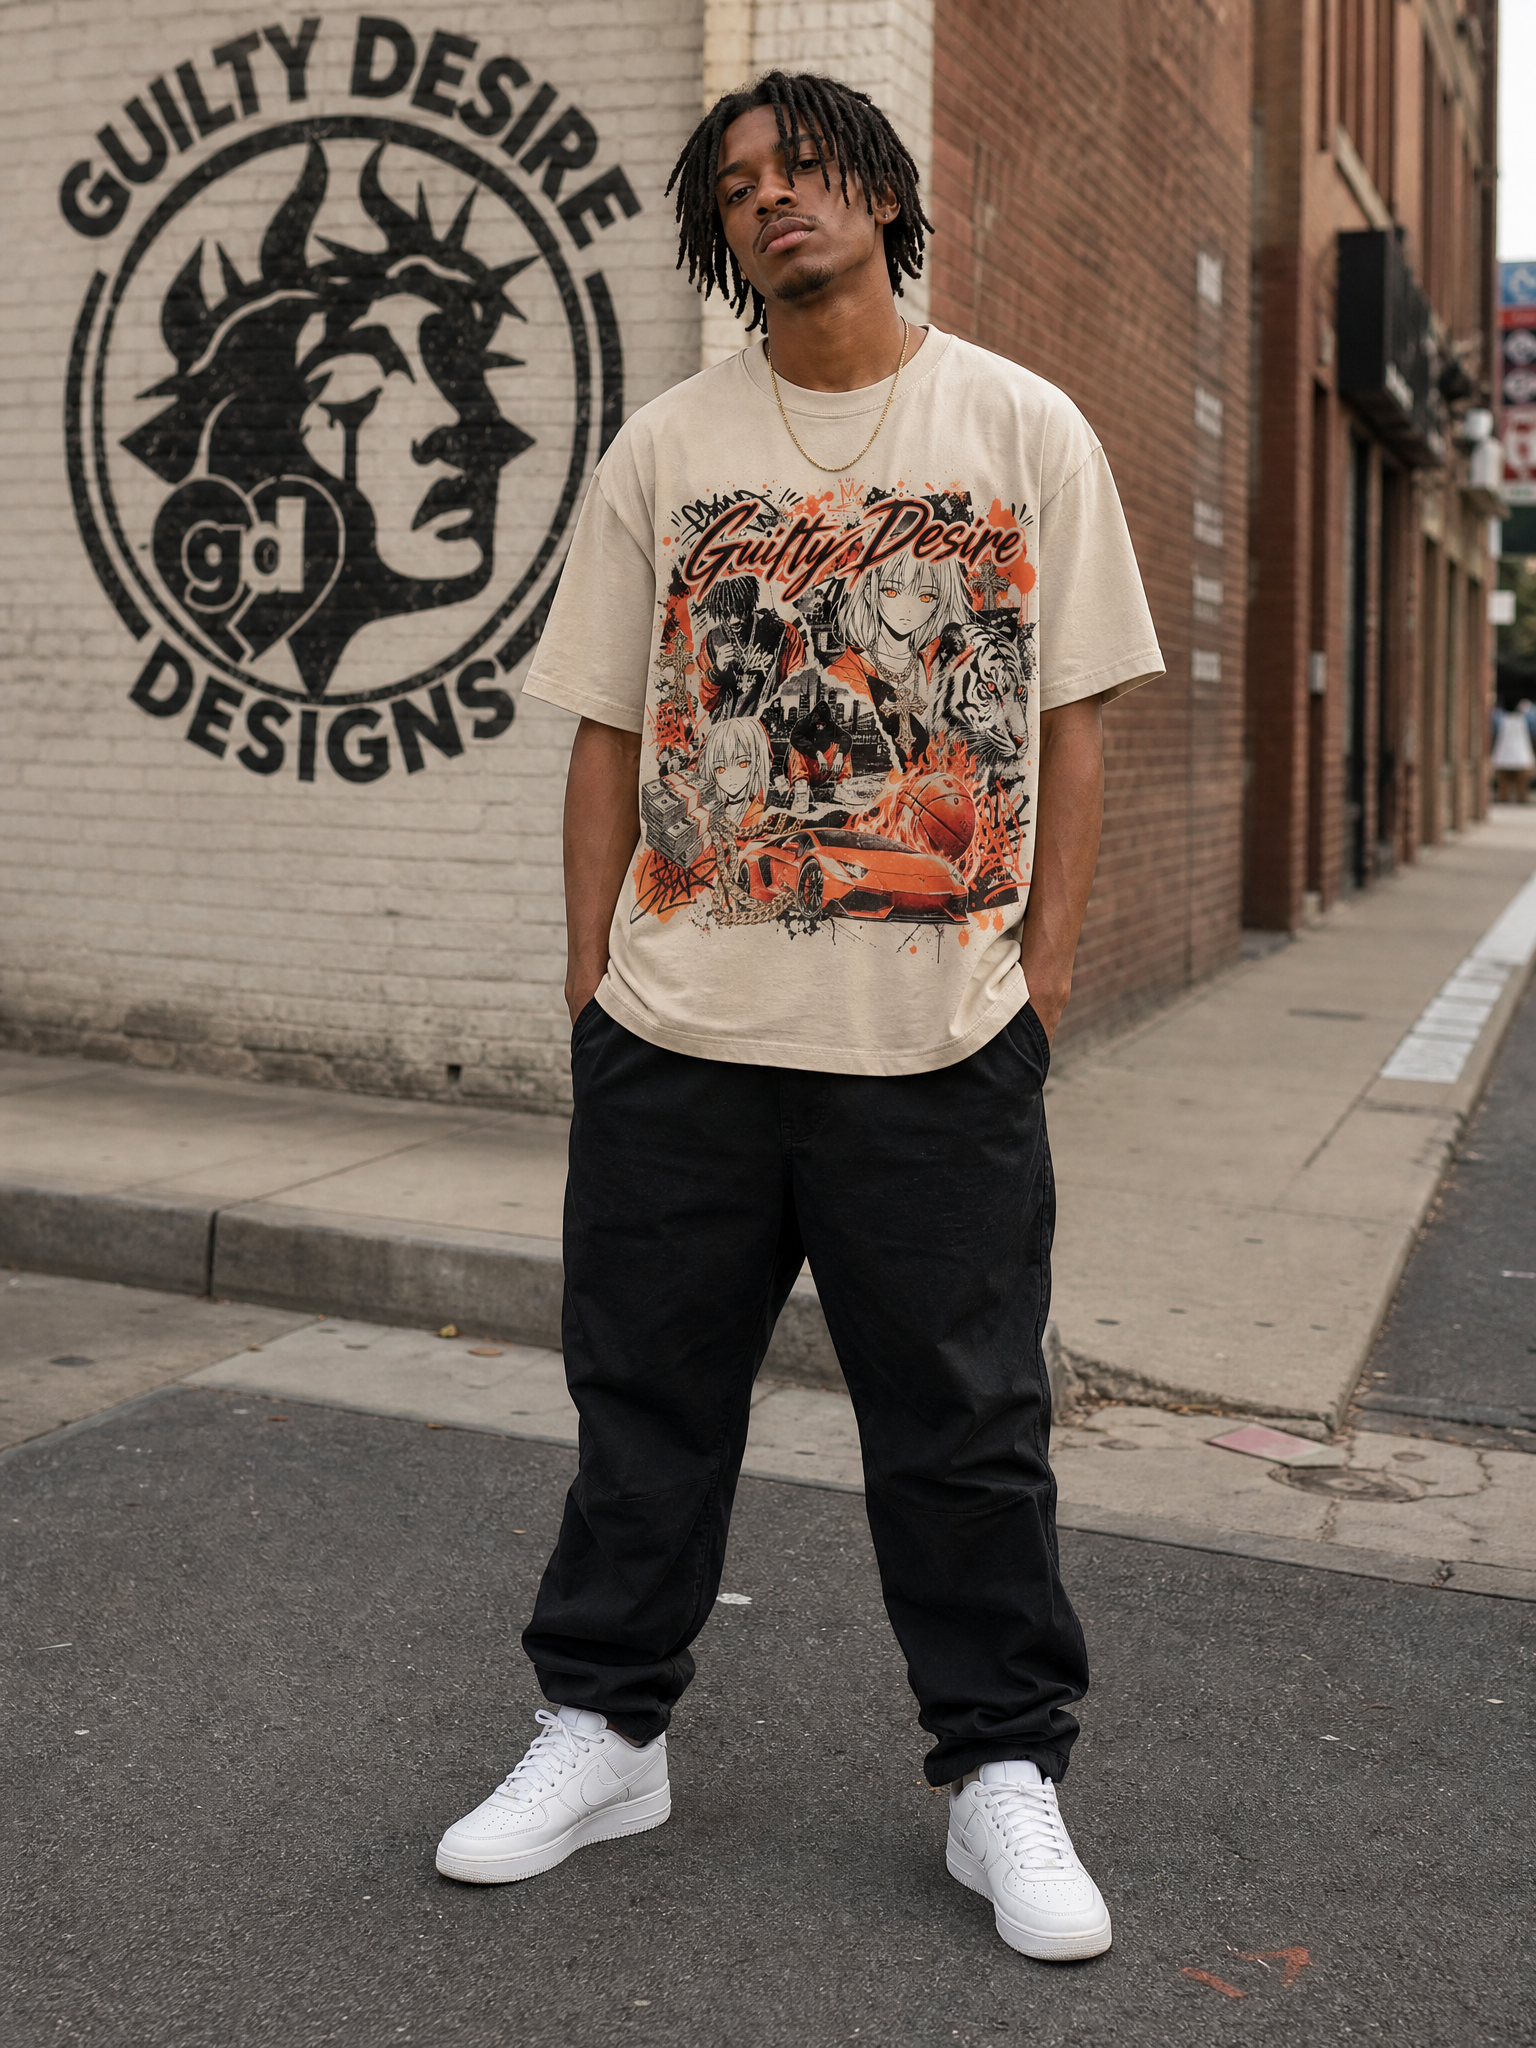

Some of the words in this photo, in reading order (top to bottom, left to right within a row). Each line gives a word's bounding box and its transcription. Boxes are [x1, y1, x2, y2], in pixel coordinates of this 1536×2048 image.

[60, 17, 321, 239] GUILTY
[350, 16, 643, 250] DESIRE
[181, 496, 306, 615] gd
[684, 500, 862, 603] Guilty
[836, 497, 1022, 592] Desire
[128, 639, 516, 784] DESIGNS
